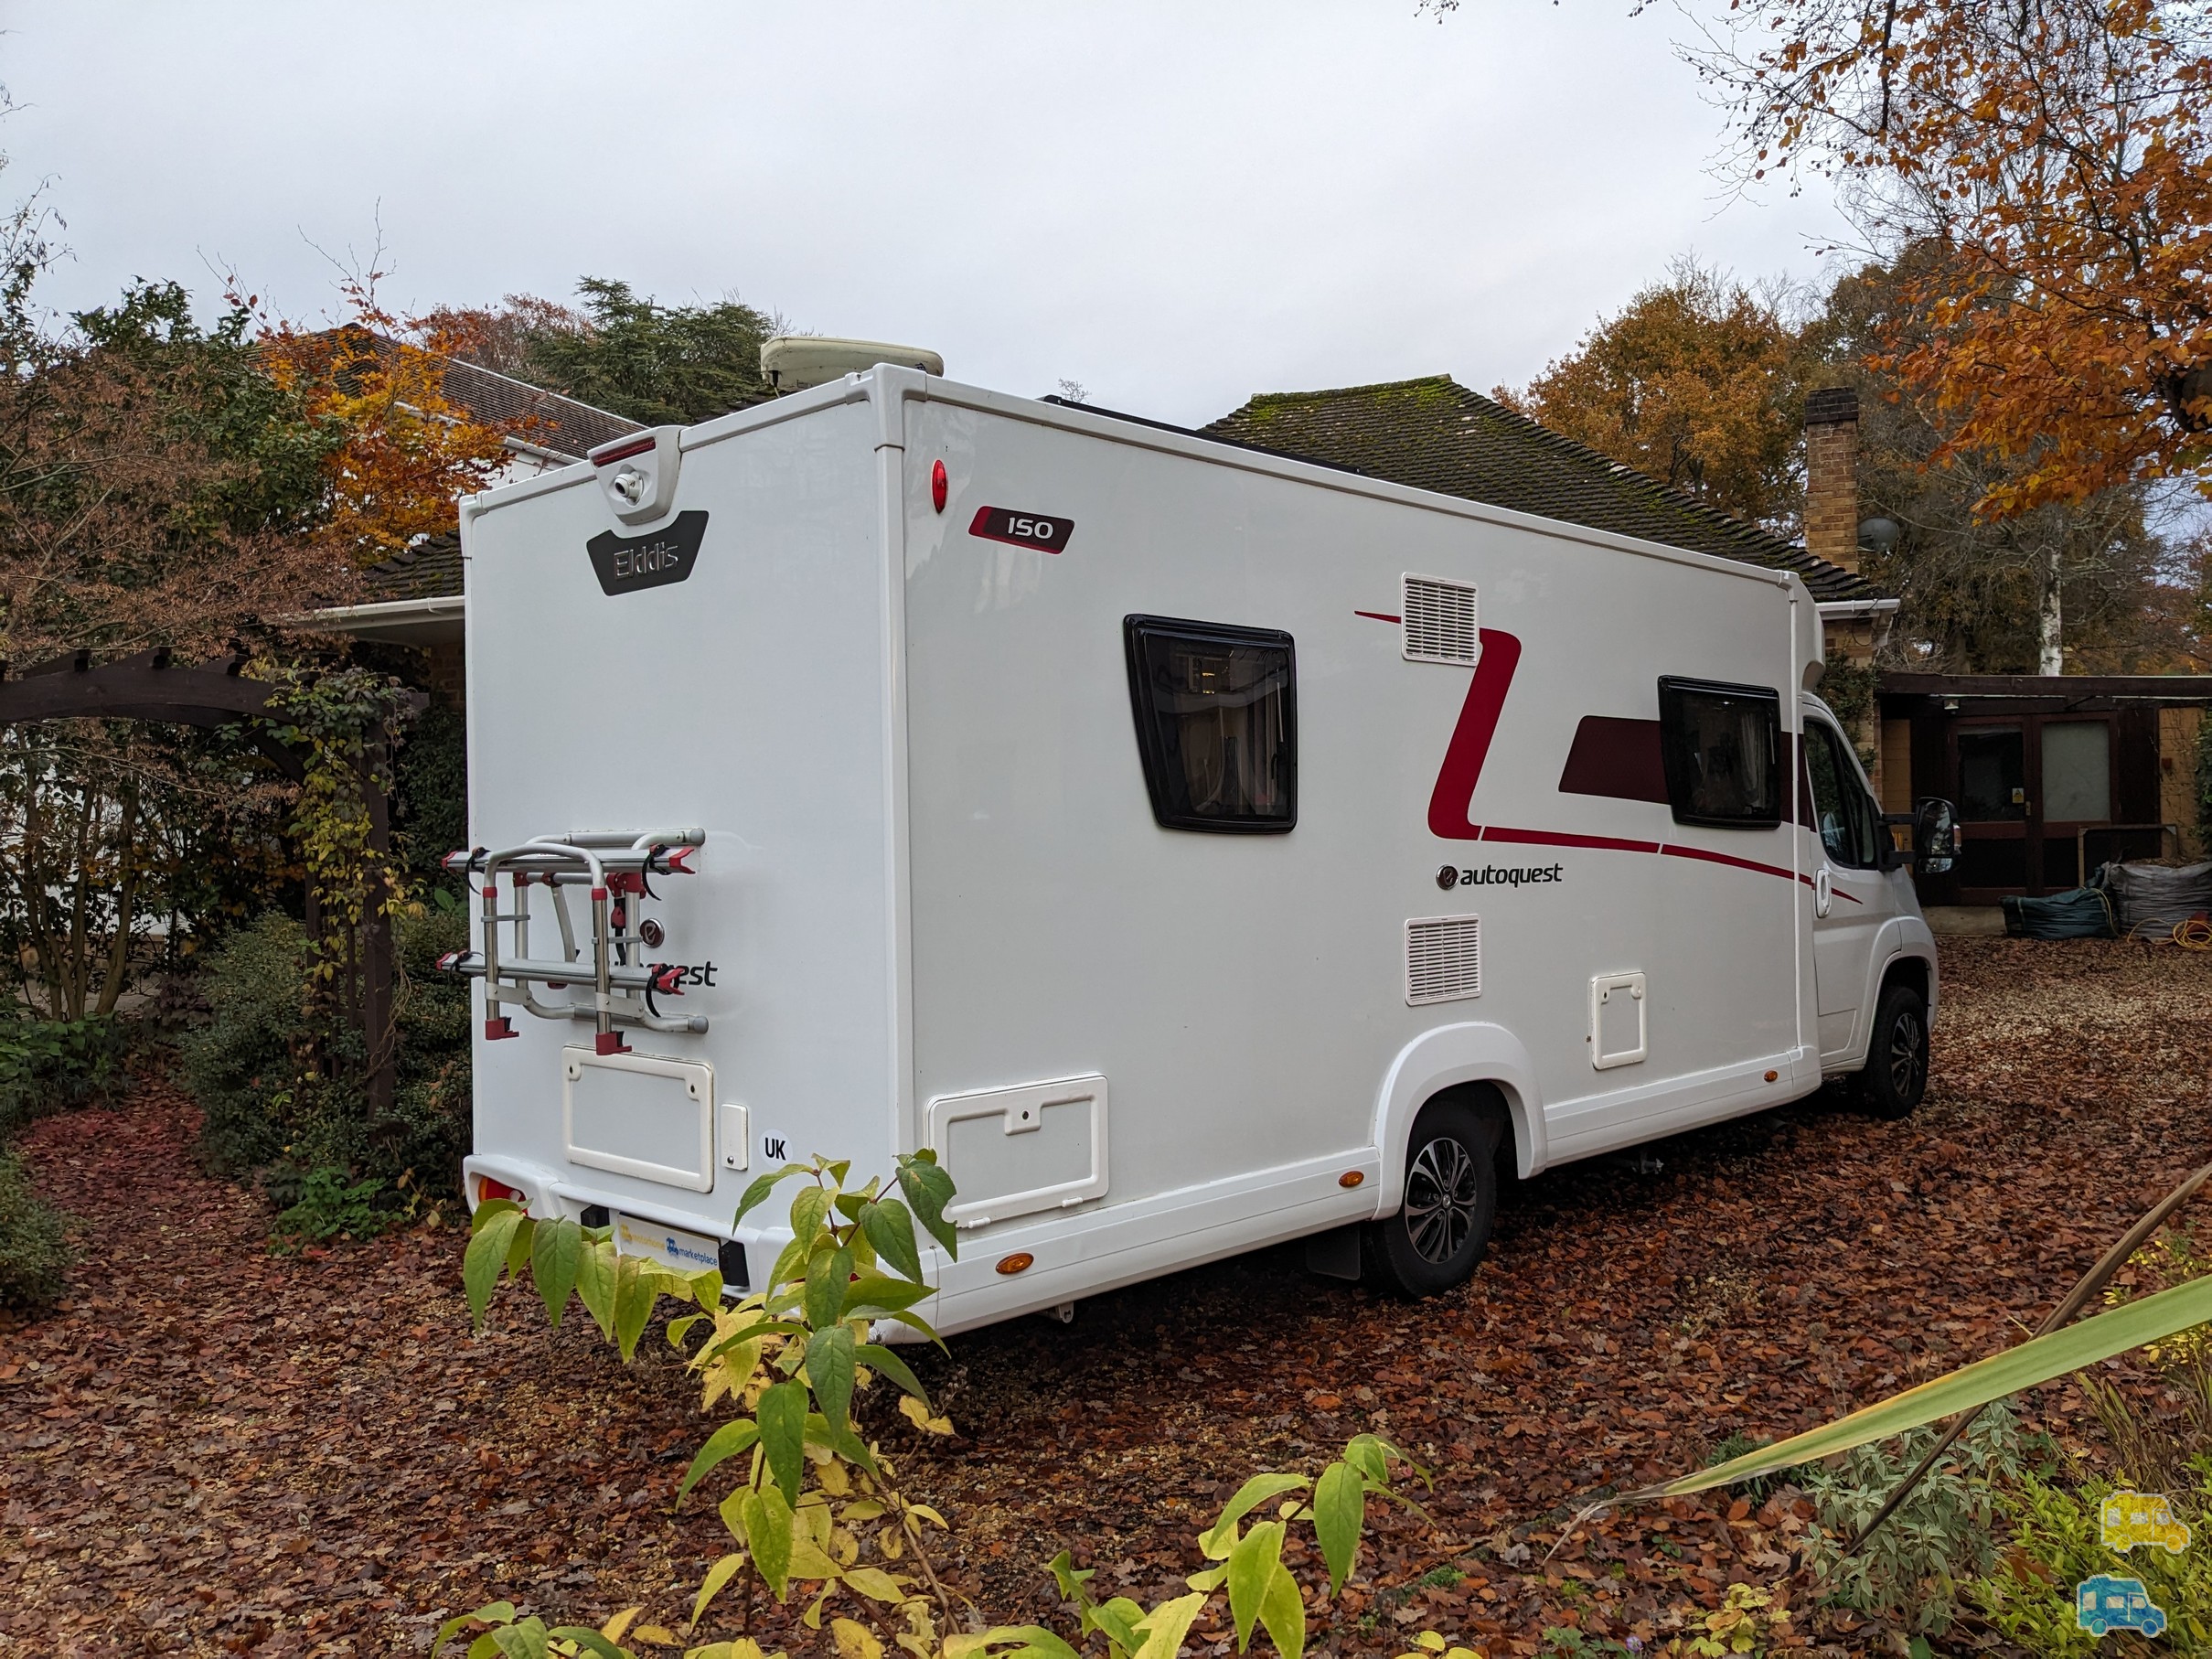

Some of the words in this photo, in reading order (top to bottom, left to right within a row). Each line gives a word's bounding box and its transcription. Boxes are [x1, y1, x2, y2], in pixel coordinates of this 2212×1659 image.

[1008, 517, 1053, 540] 150
[614, 541, 679, 580] Elddis
[1460, 862, 1564, 888] autoquest
[764, 1137, 786, 1161] UK
[679, 1248, 718, 1266] marketplace
